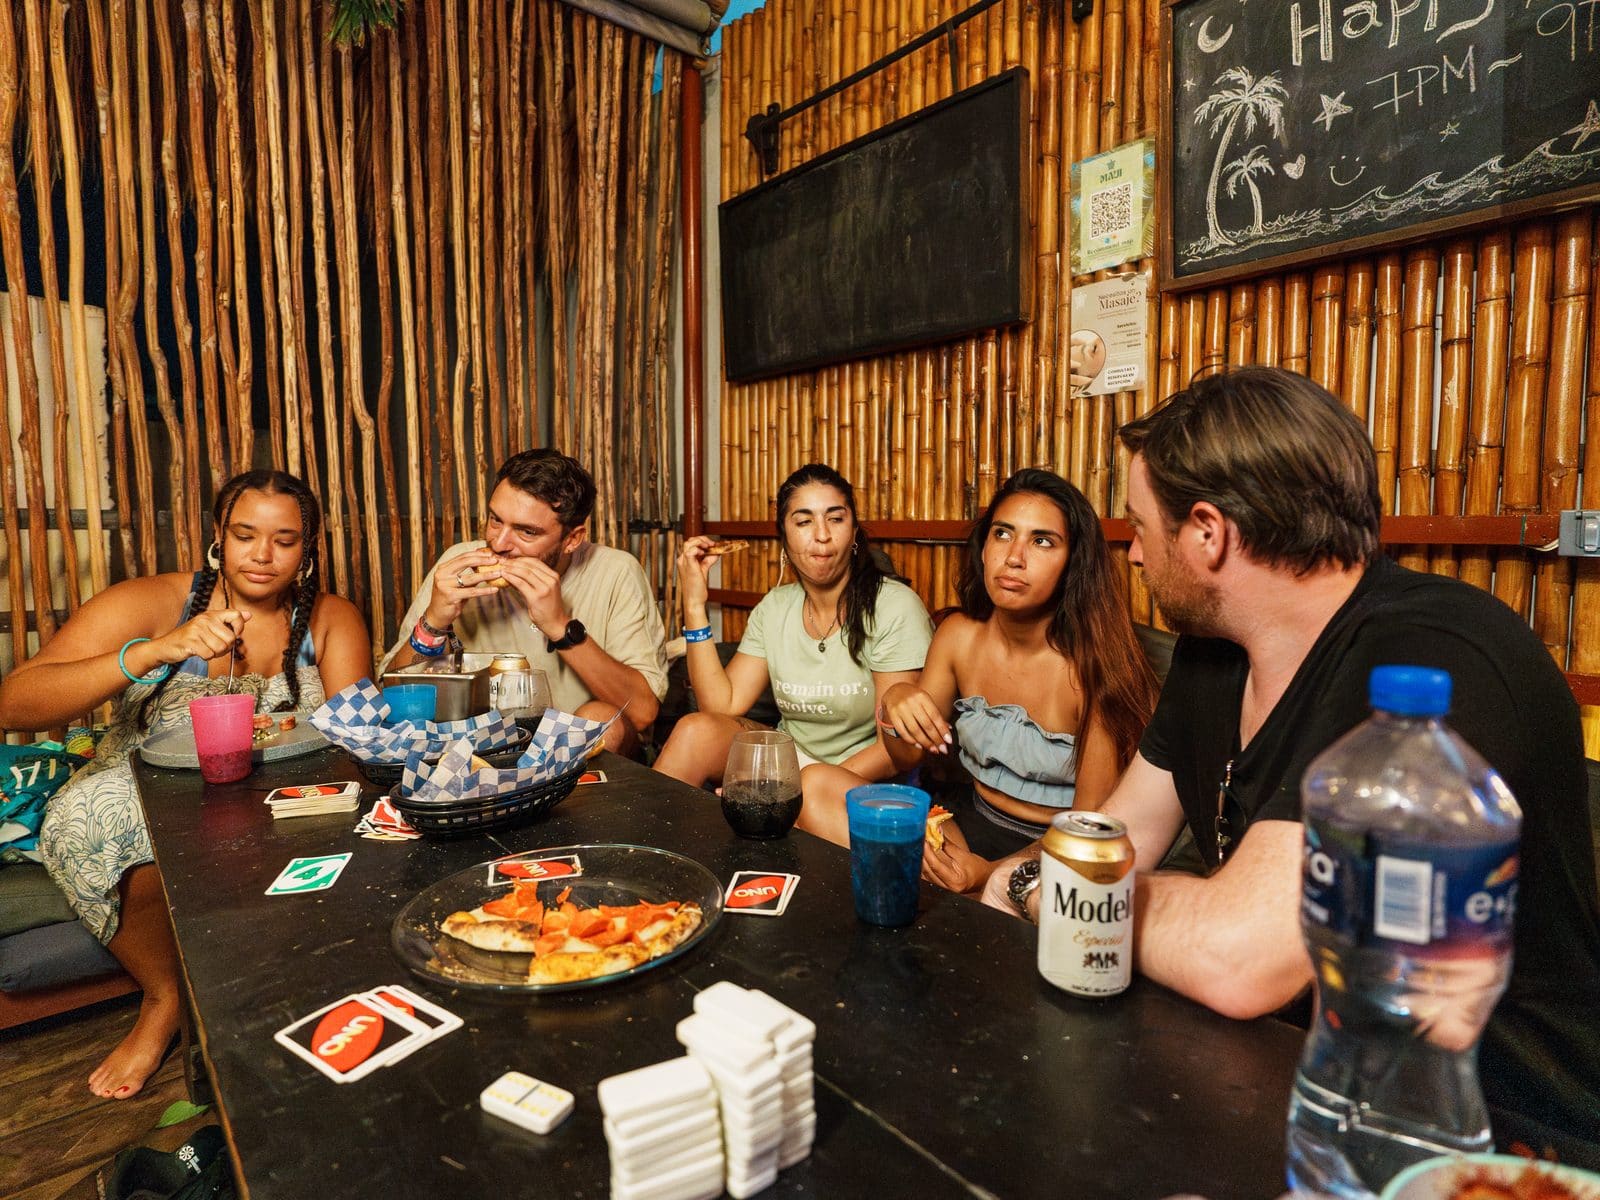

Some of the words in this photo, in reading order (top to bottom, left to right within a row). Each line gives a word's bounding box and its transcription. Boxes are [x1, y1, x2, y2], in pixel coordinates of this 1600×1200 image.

[1291, 0, 1494, 66] Hap
[775, 679, 834, 697] remain
[839, 682, 869, 696] or,
[775, 698, 834, 715] evolve.
[733, 885, 779, 899] UNO
[1054, 882, 1131, 924] Model
[317, 1014, 378, 1057] UNO
